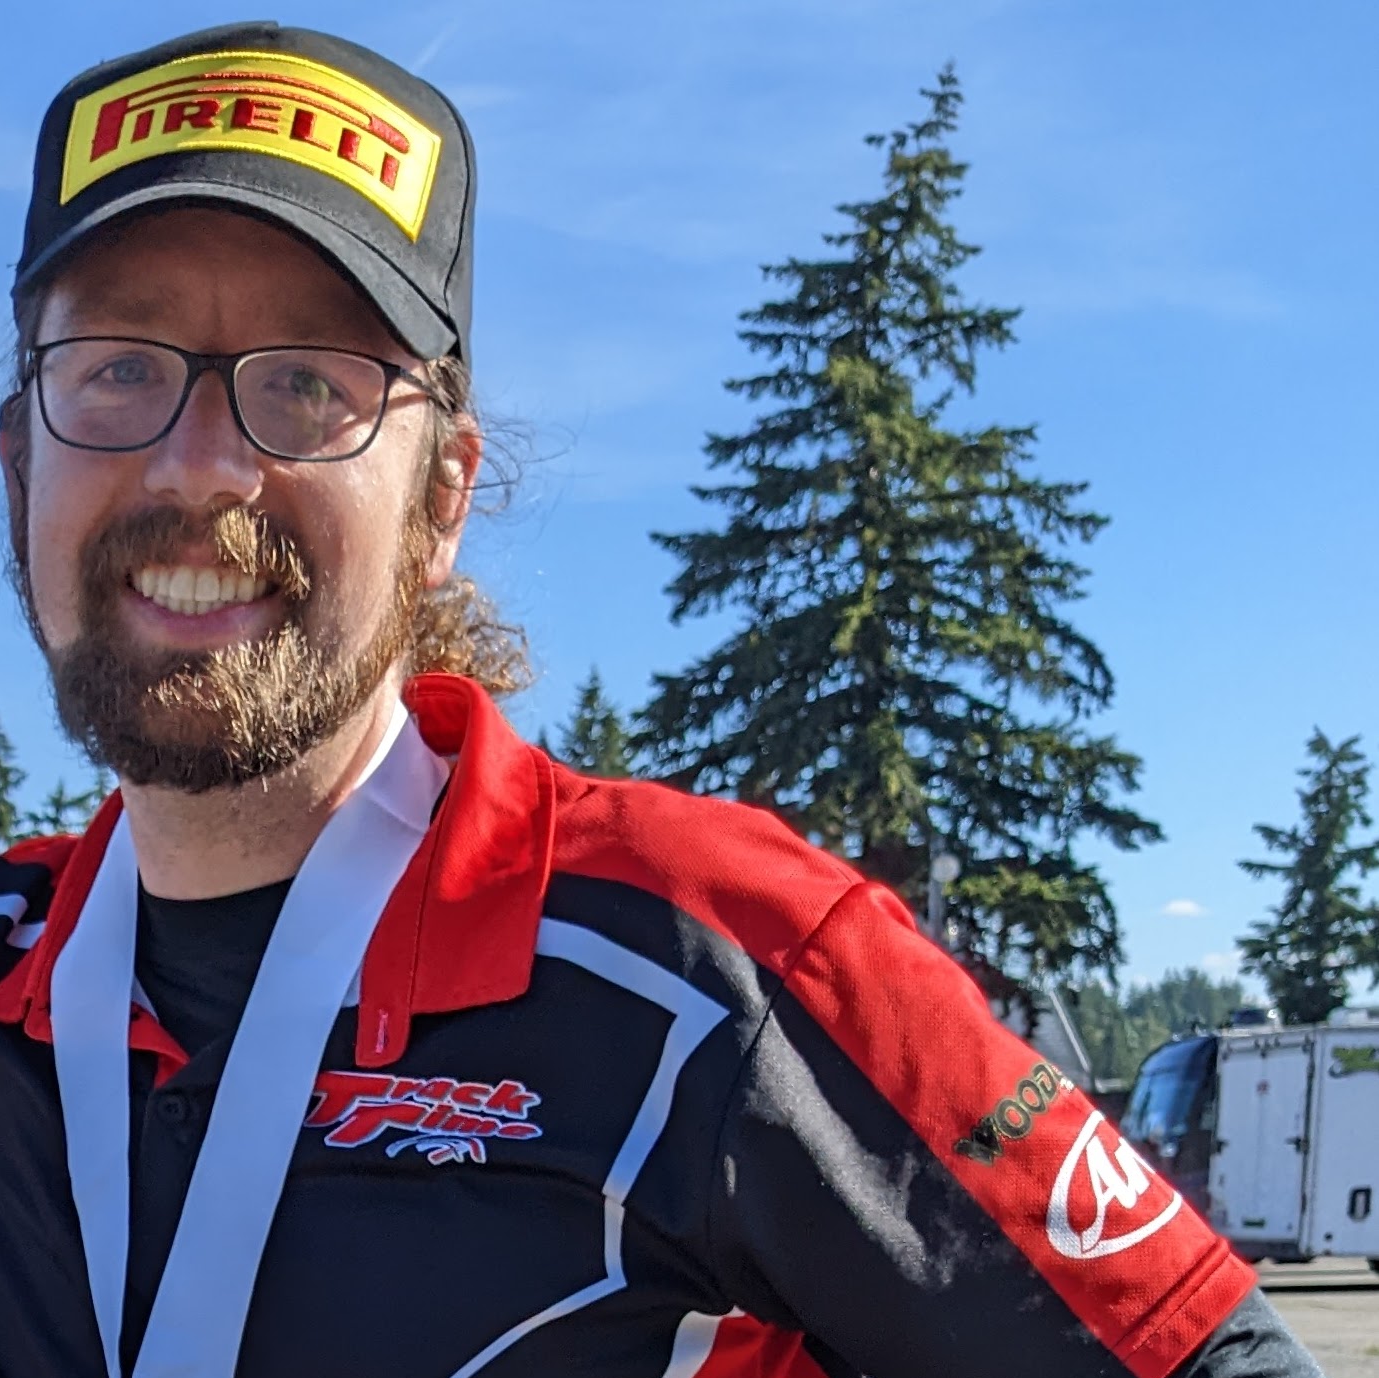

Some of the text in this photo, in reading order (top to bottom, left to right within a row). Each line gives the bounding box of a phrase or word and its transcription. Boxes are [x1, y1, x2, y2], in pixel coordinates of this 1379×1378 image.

[90, 71, 410, 190] PIRELLI
[304, 1071, 541, 1128] Track
[324, 1101, 543, 1148] Time
[953, 1062, 1062, 1167] WOOD
